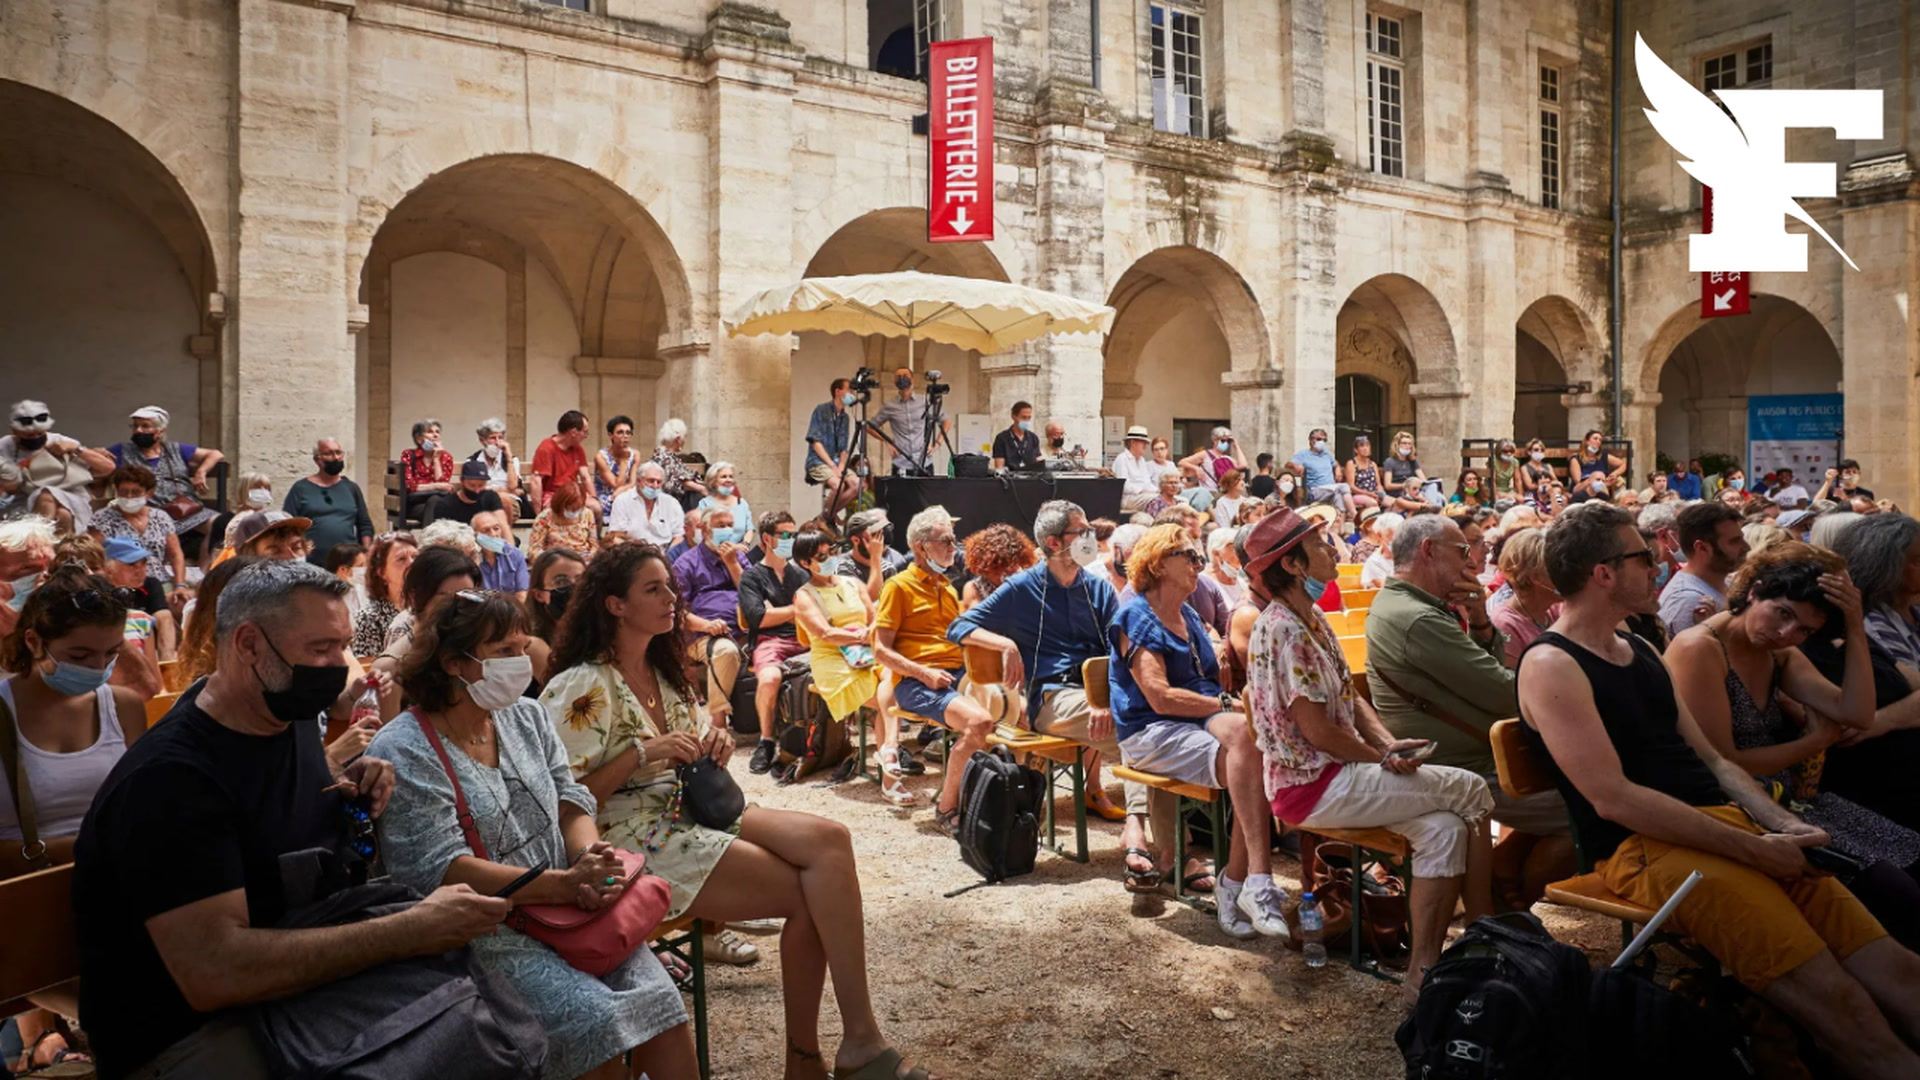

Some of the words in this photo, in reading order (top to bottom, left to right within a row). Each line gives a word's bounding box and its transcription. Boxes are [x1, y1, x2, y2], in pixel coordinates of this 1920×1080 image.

[945, 56, 978, 204] BILLETTERIE
[1757, 407, 1787, 416] MAISON
[1788, 407, 1803, 416] DES
[1804, 406, 1836, 415] PUBLICS
